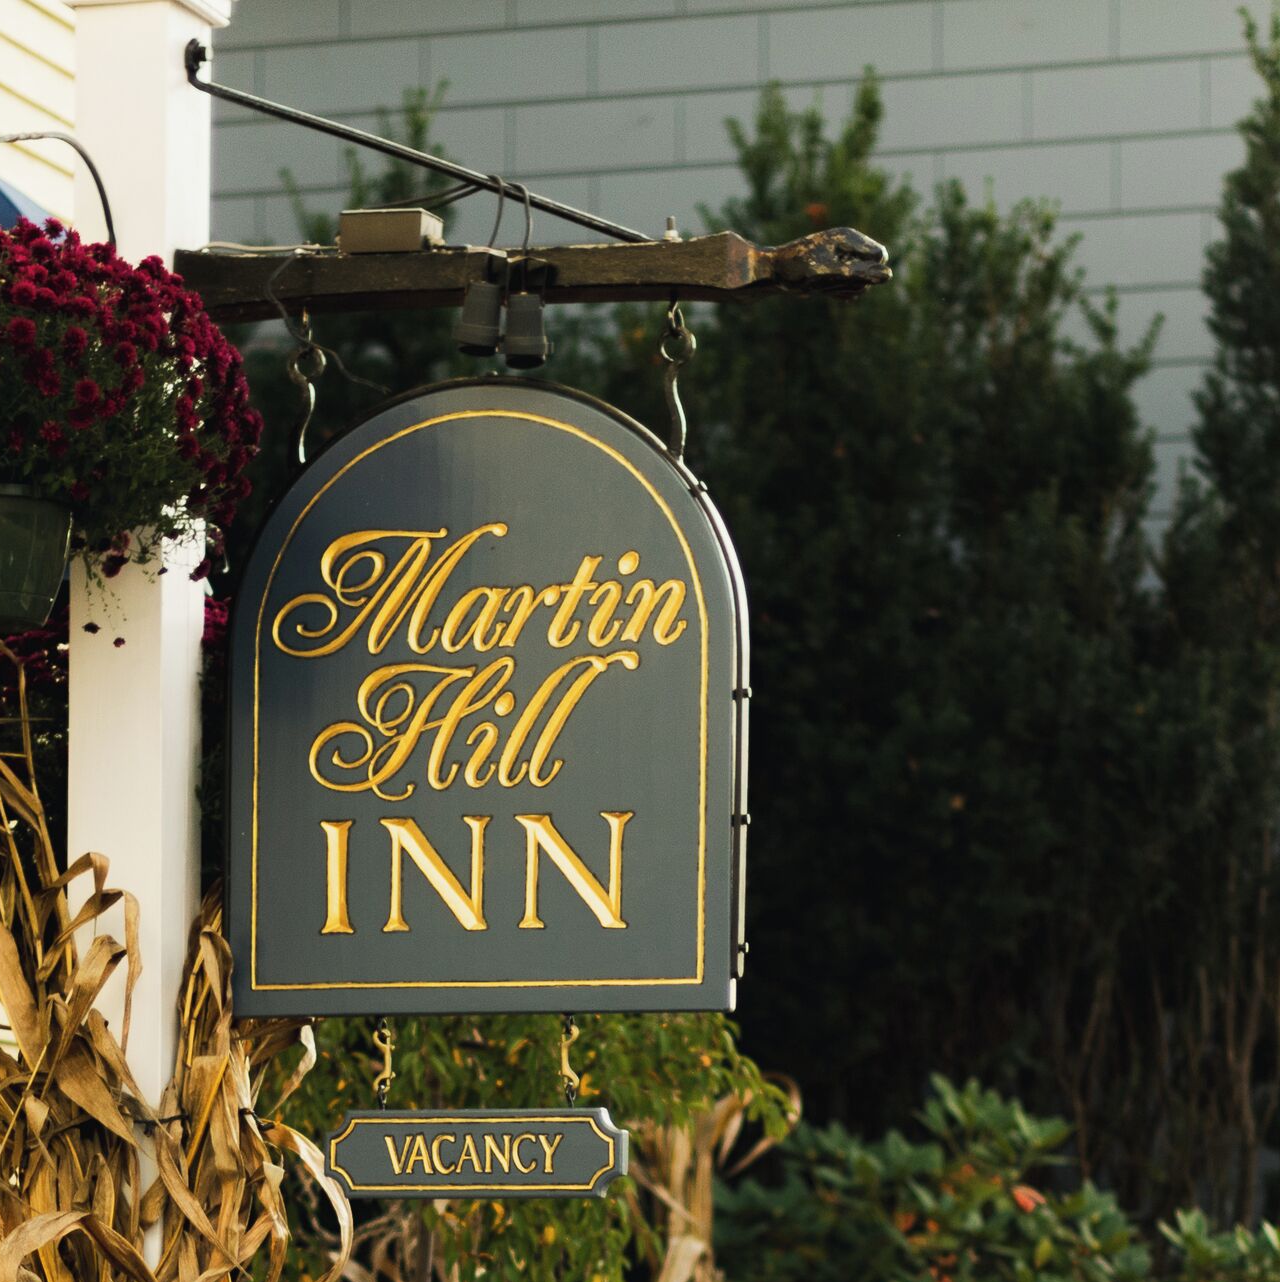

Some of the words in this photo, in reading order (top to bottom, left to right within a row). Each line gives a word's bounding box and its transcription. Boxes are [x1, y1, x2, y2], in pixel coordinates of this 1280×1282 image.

[272, 521, 689, 657] Martin
[308, 652, 640, 802] Hill
[319, 811, 634, 935] INN
[384, 1133, 563, 1176] VACANCY
